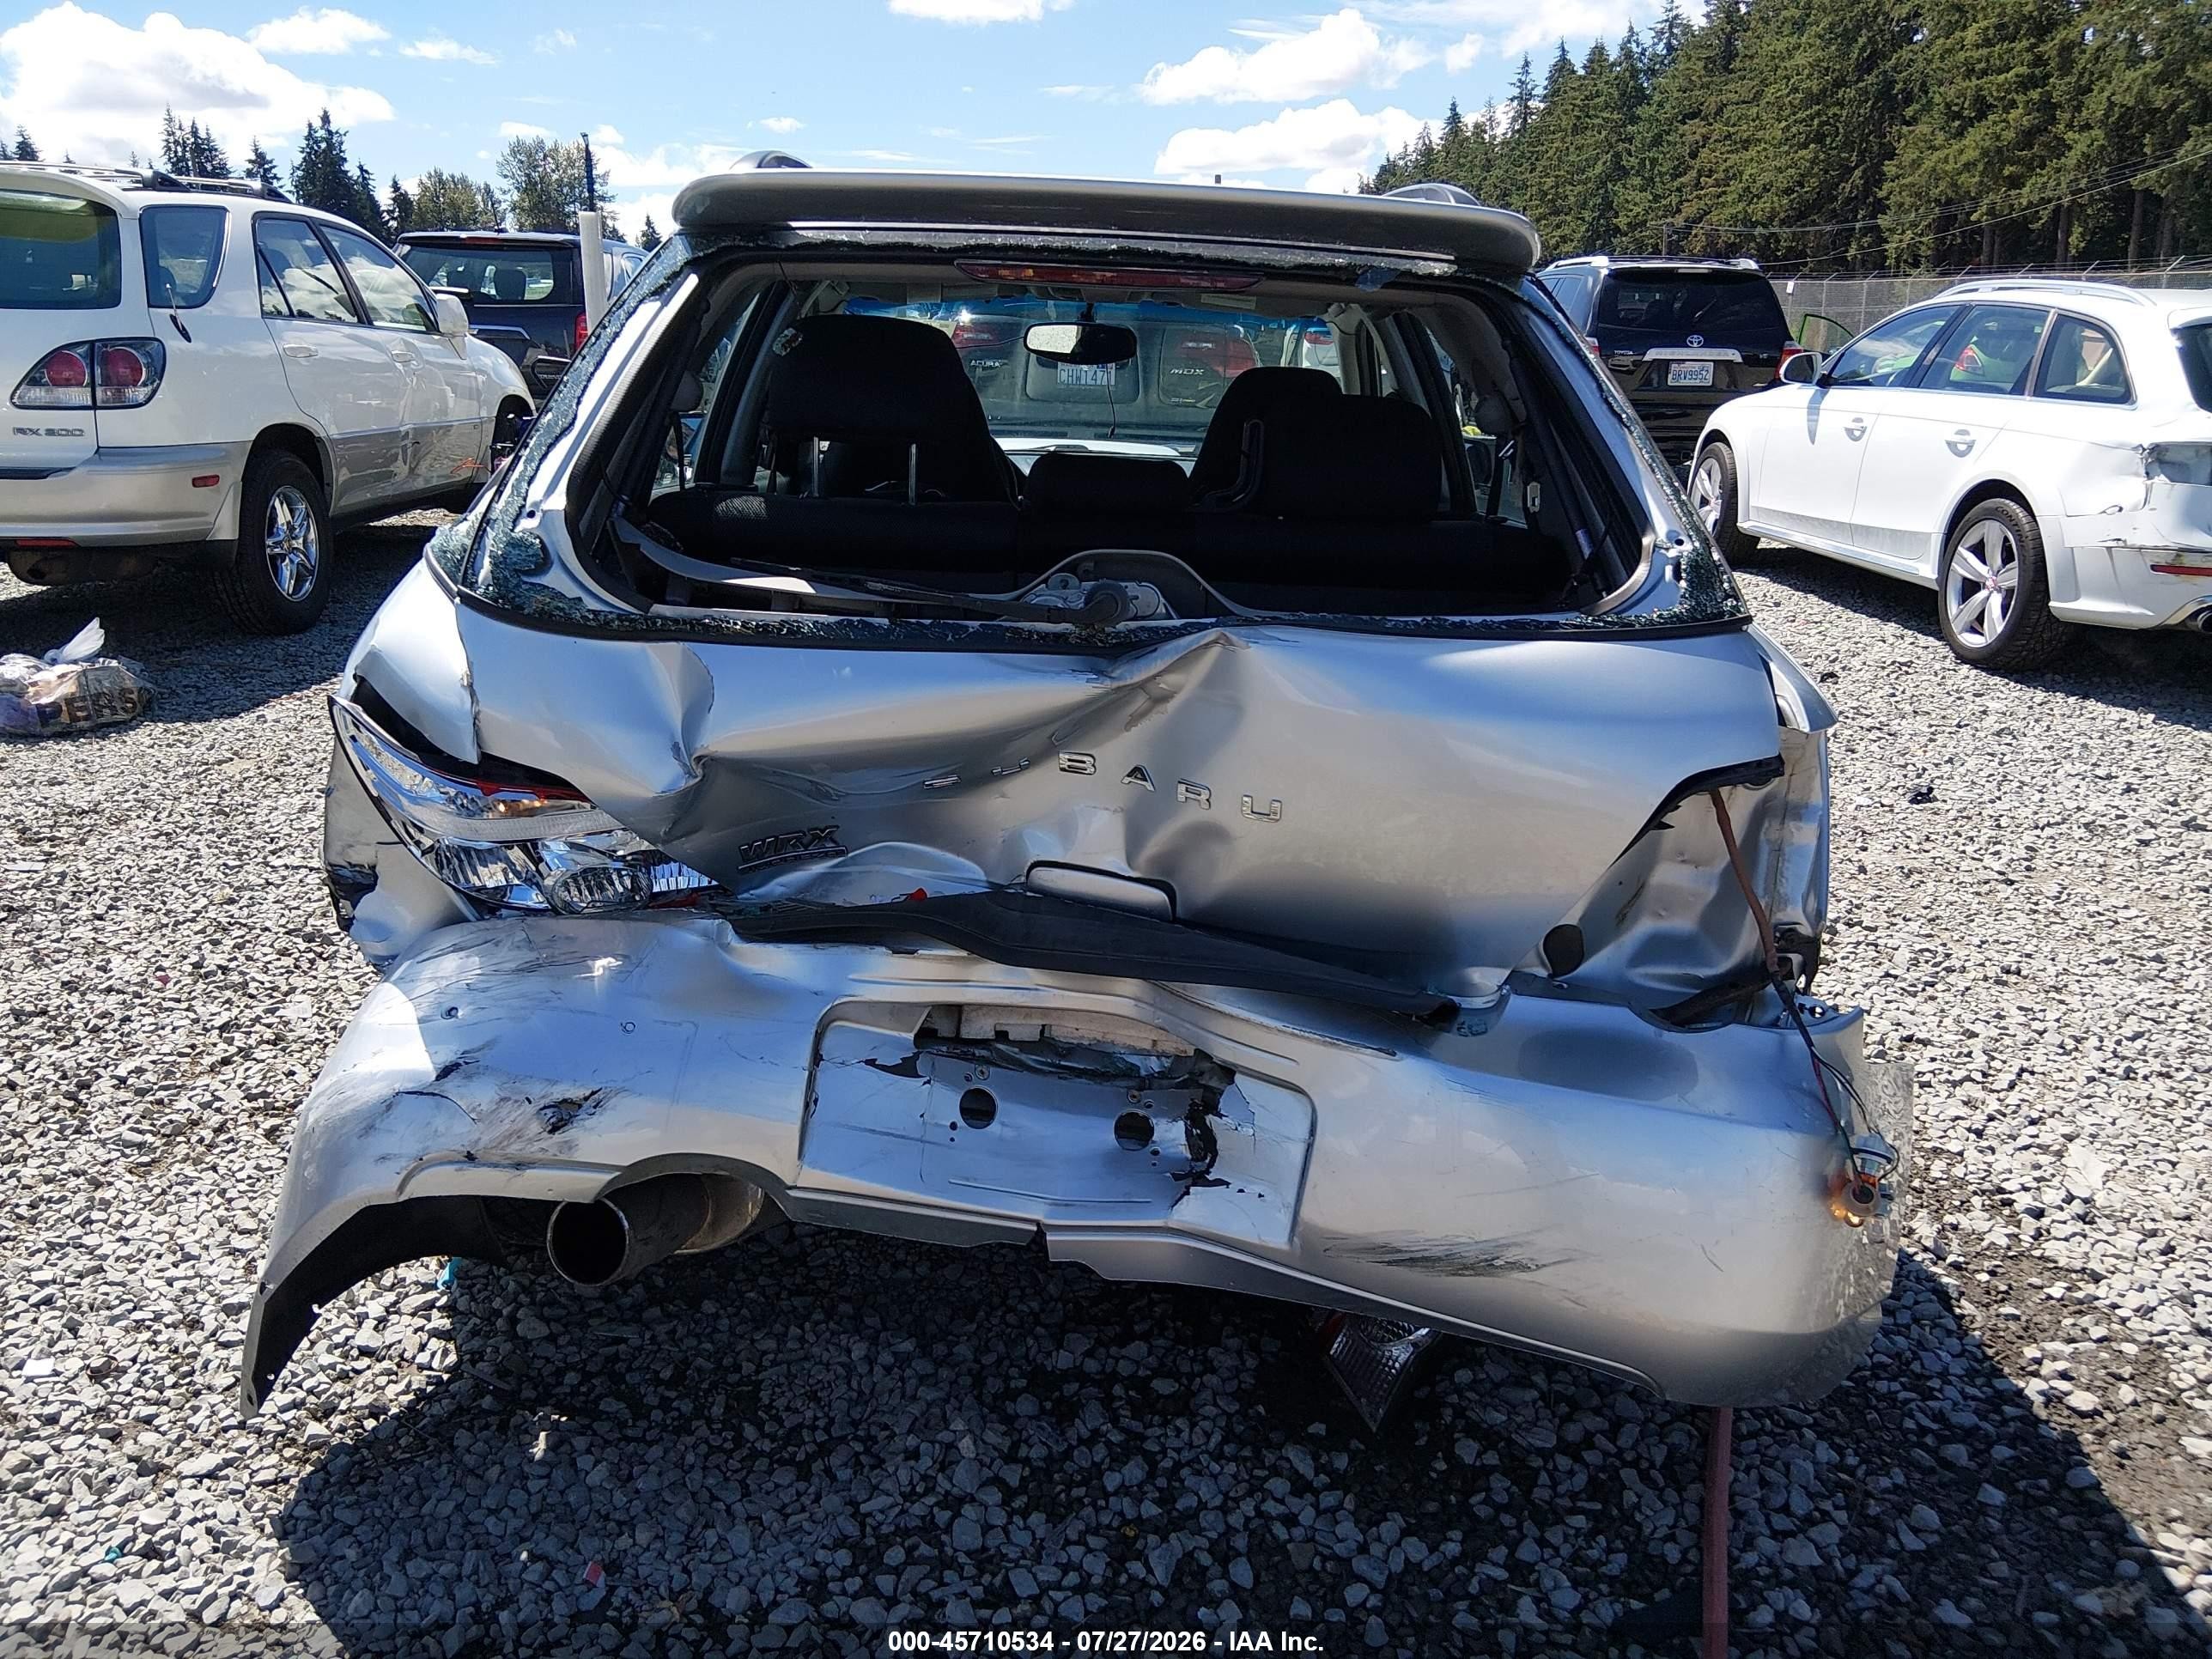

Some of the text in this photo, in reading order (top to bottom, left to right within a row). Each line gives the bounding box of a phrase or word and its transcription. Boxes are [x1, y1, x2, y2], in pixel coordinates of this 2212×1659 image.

[970, 359, 1001, 368] ACURA
[1059, 368, 1112, 385] CHW1471
[1672, 369, 1710, 380] BRV9952
[13, 427, 85, 437] RX 300
[738, 825, 841, 862] WRX
